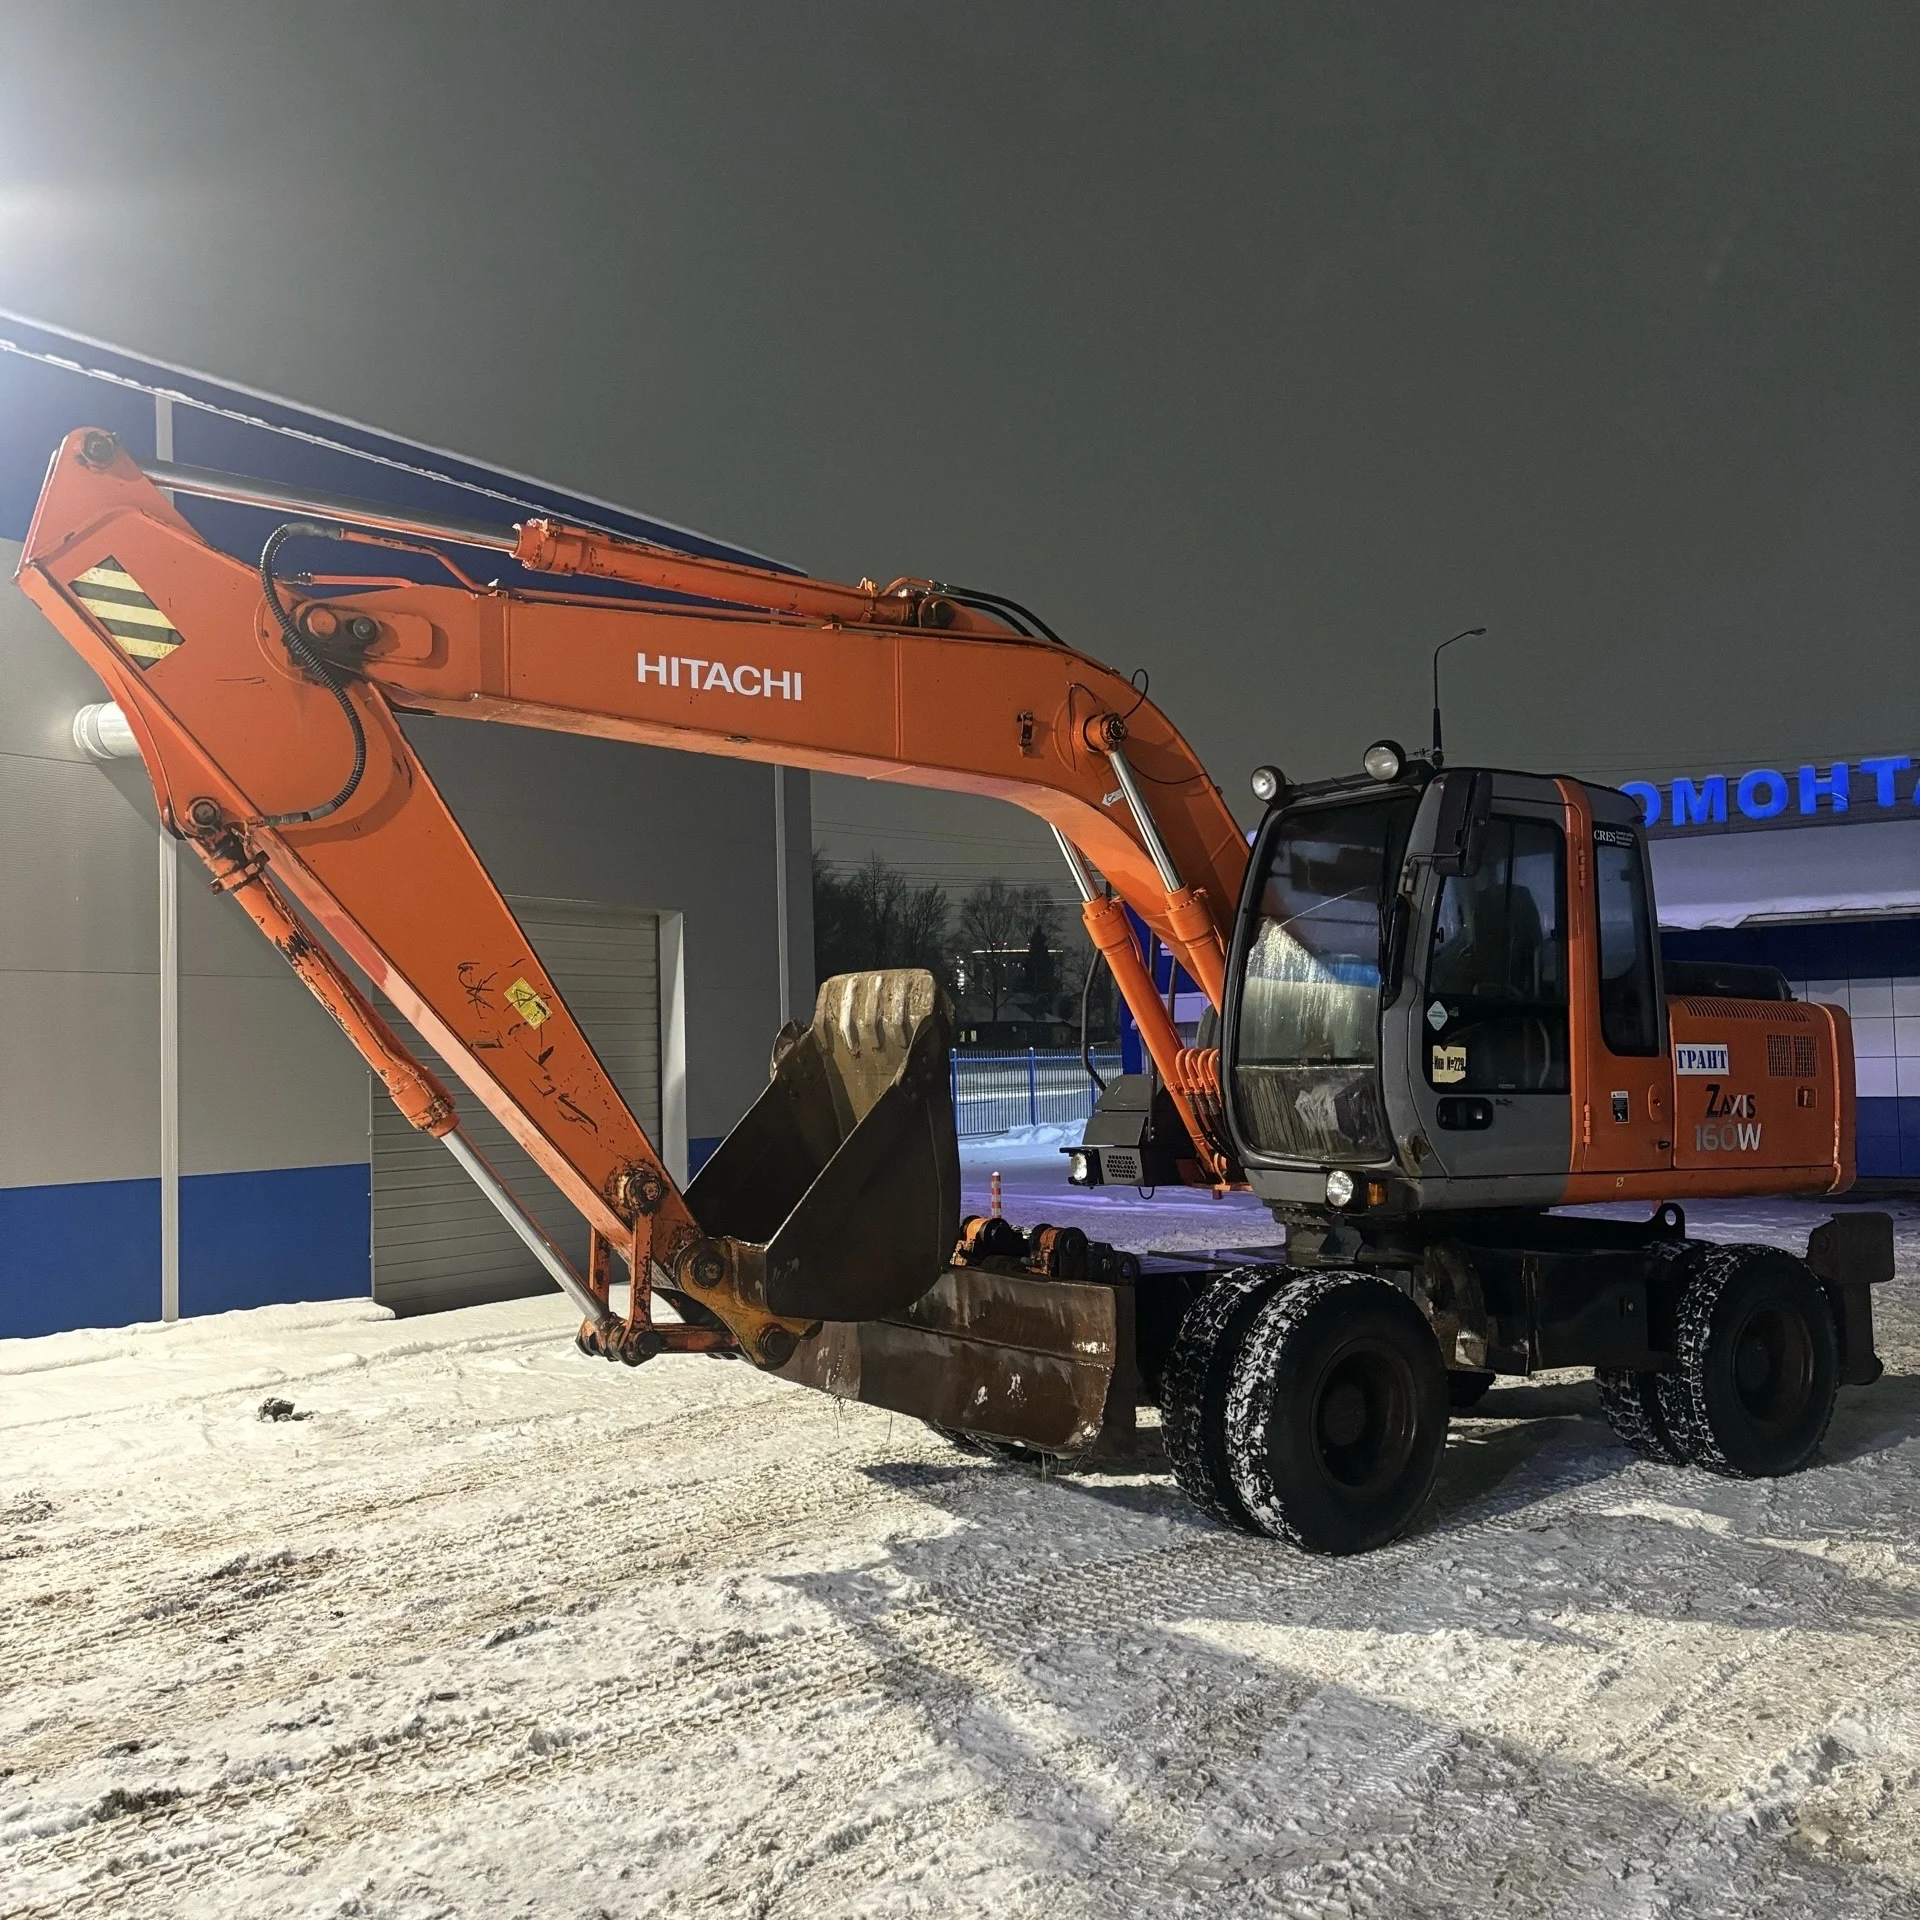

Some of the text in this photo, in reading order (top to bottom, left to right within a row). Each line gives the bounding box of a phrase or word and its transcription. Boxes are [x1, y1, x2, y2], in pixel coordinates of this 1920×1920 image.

[637, 652, 802, 701] HITACHI
[1618, 755, 1920, 829] ОМОНТ
[1593, 829, 1616, 843] CRES
[1677, 1050, 1727, 1069] ГРАНТ
[1694, 1122, 1762, 1152] 160W
